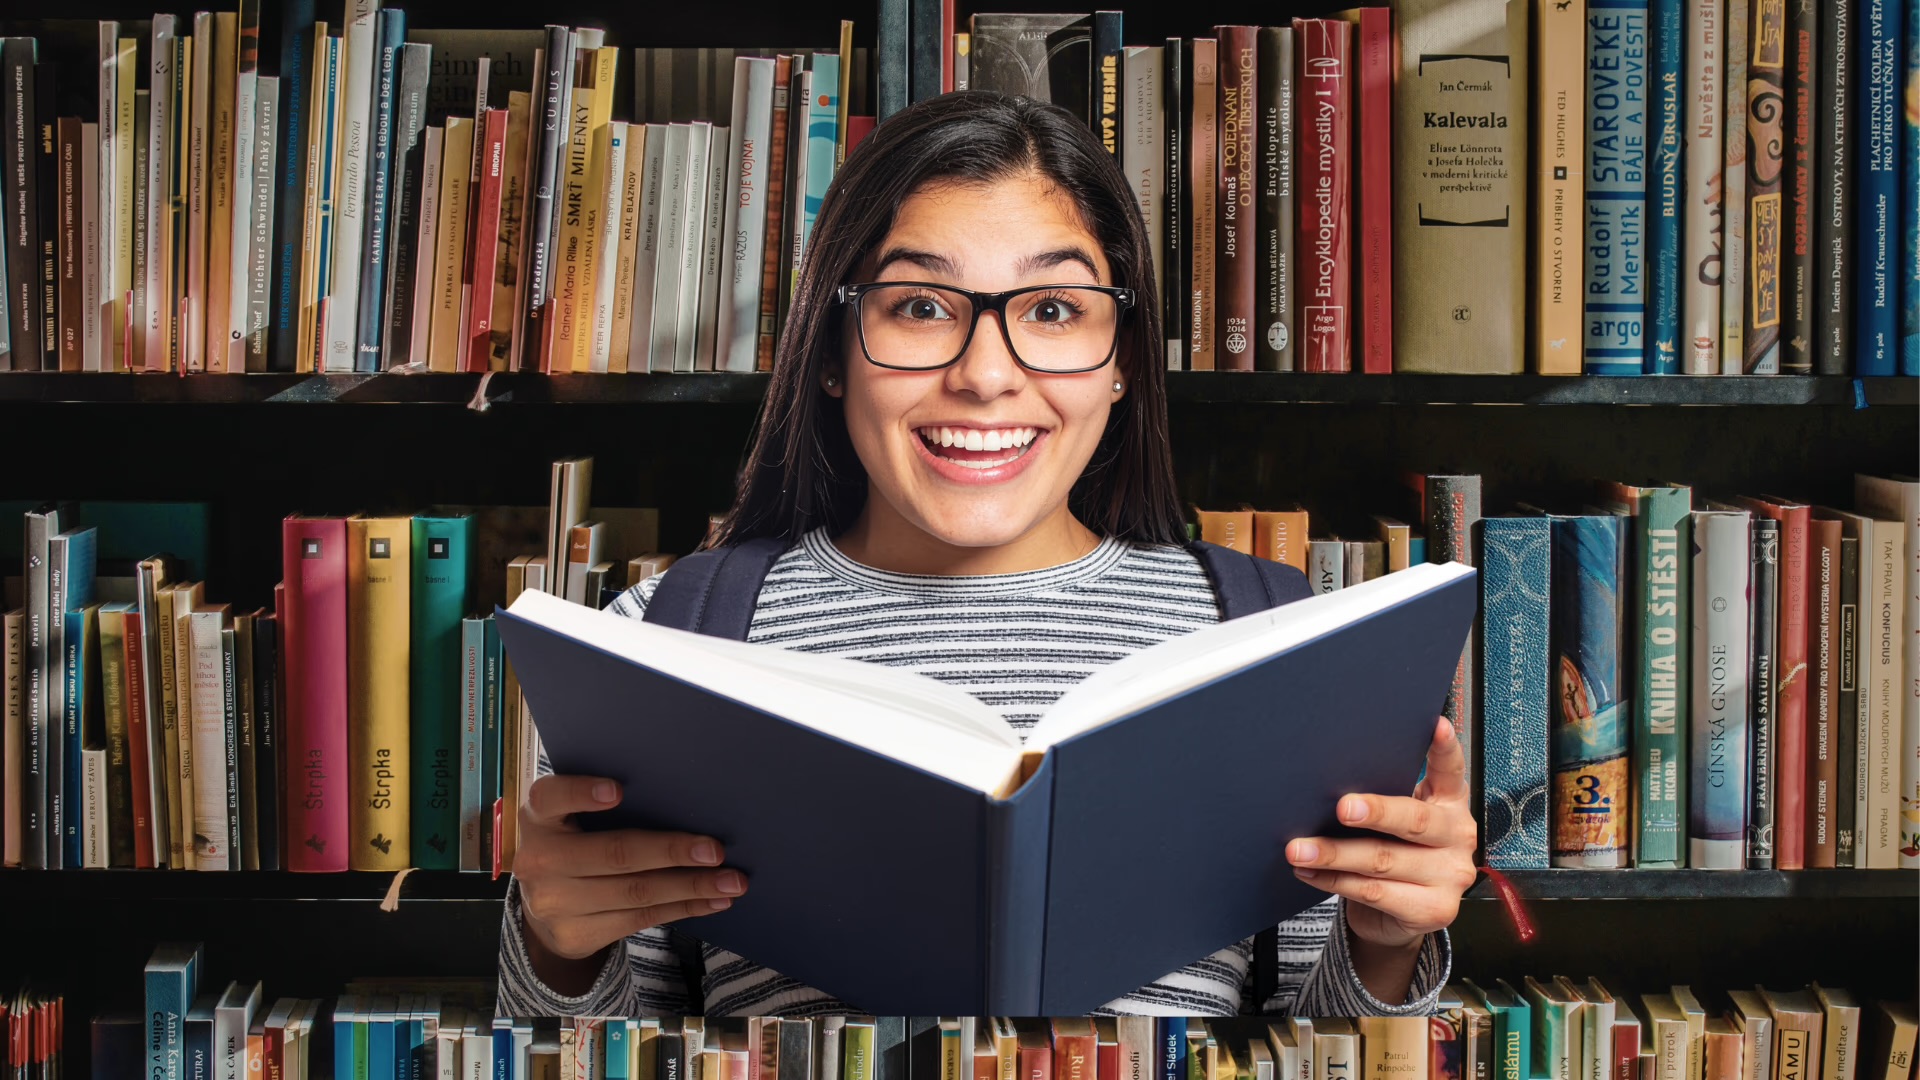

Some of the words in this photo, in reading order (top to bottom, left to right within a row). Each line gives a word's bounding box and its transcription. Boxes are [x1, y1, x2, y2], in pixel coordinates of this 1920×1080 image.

[381, 47, 392, 73] teba
[1623, 16, 1642, 100] POVĚSTI
[1872, 41, 1882, 83] KOLEM
[1882, 38, 1894, 101] TUČŇÁKA
[15, 65, 23, 90] POÉZIE
[380, 77, 391, 97] bez
[1102, 56, 1116, 113] VESMÍR
[1439, 82, 1454, 92] Jan
[1457, 81, 1492, 92] Čermák
[16, 92, 24, 139] ZDAŇOVANIU
[546, 70, 560, 130] KUBUS
[1280, 79, 1292, 144] mytologie
[1558, 90, 1566, 109] TED
[1590, 16, 1619, 182] STAROVĚKÉ
[1663, 72, 1677, 145] BRUSLAŘ
[1698, 66, 1713, 138] Nevěsta
[1834, 89, 1845, 144] KTERÝCH
[376, 114, 388, 146] tebou
[1224, 88, 1237, 166] POJEDNÁNÍ
[1316, 100, 1335, 172] mystiky
[1423, 112, 1508, 128] Kalevala
[1557, 115, 1566, 158] HUGHES
[1625, 113, 1641, 124] A
[1870, 87, 1882, 170] PLACHETNICÍ
[1882, 104, 1893, 142] PÍRKO
[348, 121, 361, 158] Pessoa
[571, 103, 589, 175] MILENKY
[1267, 108, 1278, 196] Encyklopedie
[1430, 144, 1457, 153] Eliase
[1460, 144, 1502, 153] Lönnrota
[1835, 148, 1843, 165] NA
[1883, 146, 1892, 170] PRO
[17, 164, 25, 186] VERŠE
[491, 142, 501, 176] EUROPAIN
[741, 140, 753, 177] VOJNA!
[1238, 133, 1252, 189] VĚCECH
[1279, 150, 1288, 196] baltské
[1430, 170, 1469, 179] moderní
[1472, 170, 1508, 179] kritické
[1435, 156, 1462, 166] Josefa
[1466, 156, 1503, 166] Holečka
[1622, 136, 1642, 181] BÁJE
[344, 162, 359, 218] Fernando
[374, 171, 384, 221] PETERAJ
[739, 193, 750, 208] TO
[741, 180, 752, 190] JE
[1224, 177, 1236, 219] Kolmaš
[1241, 195, 1251, 206] O
[1440, 183, 1492, 193] perspektivě
[1662, 148, 1675, 217] BLUDNÝ
[1833, 168, 1844, 226] OSTROVY,
[18, 190, 26, 214] Machej
[257, 184, 268, 242] Schwindel
[566, 183, 582, 226] SMRŤ
[19, 216, 27, 246] Zbigniew
[136, 231, 145, 265] SKLÁDÁM
[371, 228, 382, 263] KAMIL
[566, 237, 578, 262] Rilke
[1225, 226, 1235, 257] Josef
[1315, 176, 1334, 299] Encyklopedie
[1589, 204, 1611, 293] Rudolf
[1875, 194, 1886, 270] Krautschneider
[532, 242, 544, 288] Podracká
[1620, 207, 1639, 294] Mertlík
[1832, 237, 1842, 278] Deprijck
[254, 248, 265, 293] leichter
[563, 266, 575, 299] Maria
[531, 293, 541, 318] Dana
[1278, 284, 1286, 312] VÁCLAV
[1832, 281, 1841, 312] Lucien
[1875, 273, 1885, 307] Rudolf
[254, 311, 262, 329] Naef
[480, 320, 487, 328] 73
[560, 303, 572, 340] Rainer
[598, 305, 606, 328] REPKA
[1314, 325, 1335, 333] Logos
[1316, 315, 1333, 323] Argo
[1591, 321, 1640, 345] argo
[253, 331, 262, 354] Sabina
[597, 331, 605, 355] PETER
[1884, 540, 1892, 559] TAK
[52, 569, 61, 586] nódy
[1646, 529, 1676, 616] ŠTĚSTÍ
[1884, 563, 1892, 599] PRAVIL
[52, 591, 61, 607] šulej
[1821, 585, 1829, 623] MYSTERIA
[8, 624, 19, 664] PÍSNÍ
[1651, 628, 1676, 644] O
[1819, 625, 1829, 668] POCHOPENÍ
[1883, 603, 1891, 664] KONFUCIUS
[8, 675, 19, 716] PÍSEŇ
[1651, 655, 1676, 734] KNIHA
[1712, 645, 1726, 711] GNOSE
[1757, 655, 1768, 713] SATURNI
[1820, 671, 1828, 686] PRO
[30, 668, 39, 746] Sutherland-Smith
[1820, 688, 1828, 720] KAMENY
[1707, 718, 1725, 787] ČÍNSKÁ
[1819, 723, 1827, 760] STAVEBNÍ
[31, 749, 39, 774] James
[303, 750, 327, 810] Štrpka
[369, 749, 394, 810] Štrpka
[428, 749, 453, 809] Štrpka
[1650, 749, 1662, 800] MATTHIEU
[1665, 761, 1676, 800] RICARD
[1757, 717, 1768, 808] FRATERNITAS
[1818, 814, 1826, 844] RUDOLF
[1880, 808, 1888, 848] PRAGMA
[153, 1012, 163, 1052] Céline
[1666, 1032, 1675, 1070] prorok
[1836, 1026, 1847, 1071] meditace
[1167, 1034, 1176, 1069] Sládek
[1384, 1052, 1408, 1060] Patrul
